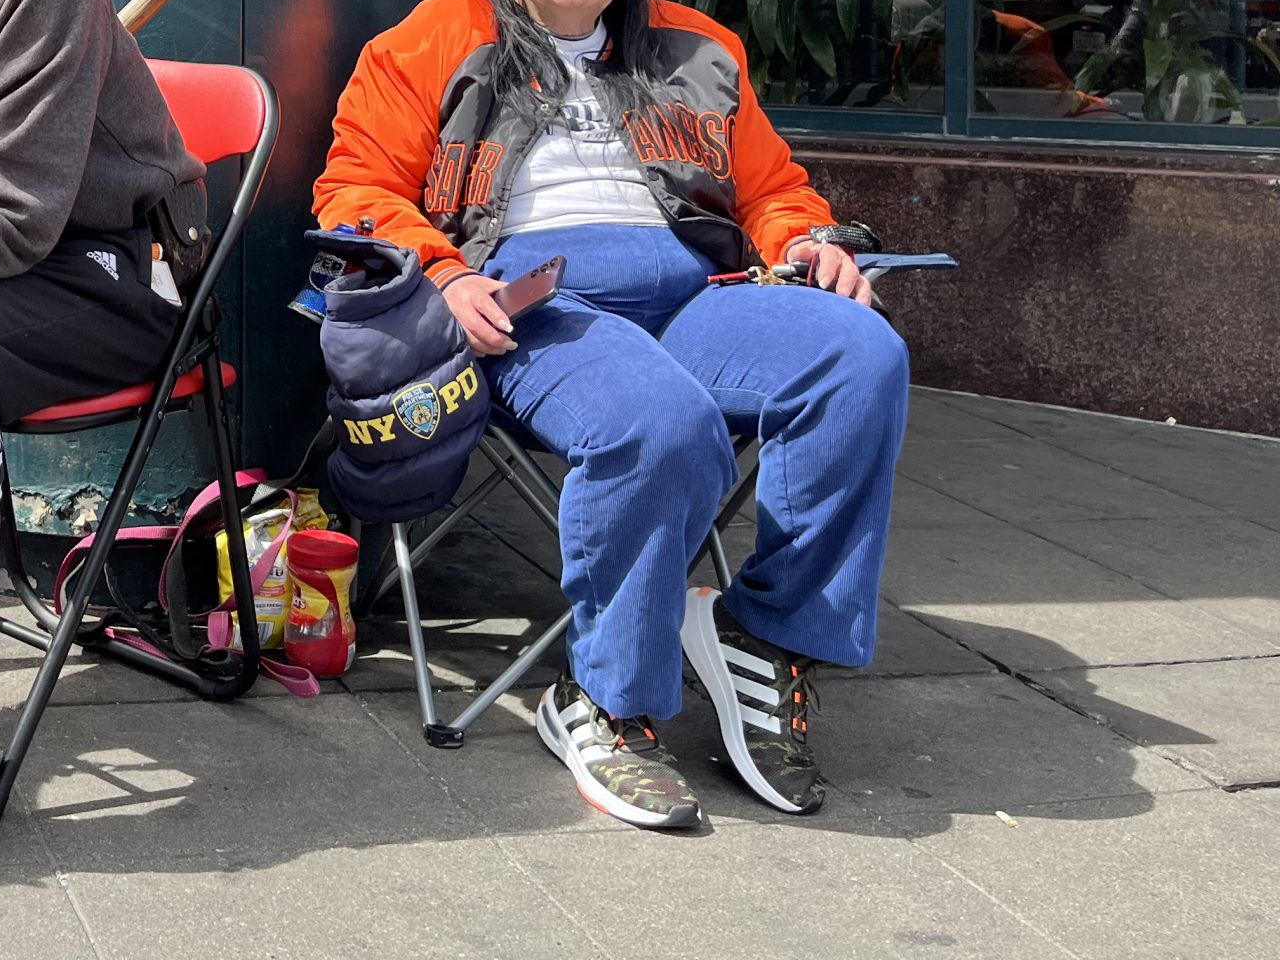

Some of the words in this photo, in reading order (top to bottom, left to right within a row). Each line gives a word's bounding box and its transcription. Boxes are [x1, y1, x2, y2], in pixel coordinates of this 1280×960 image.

[86, 251, 120, 281] adidas
[343, 413, 397, 445] NY
[438, 366, 479, 415] PD
[402, 387, 425, 402] POLICE
